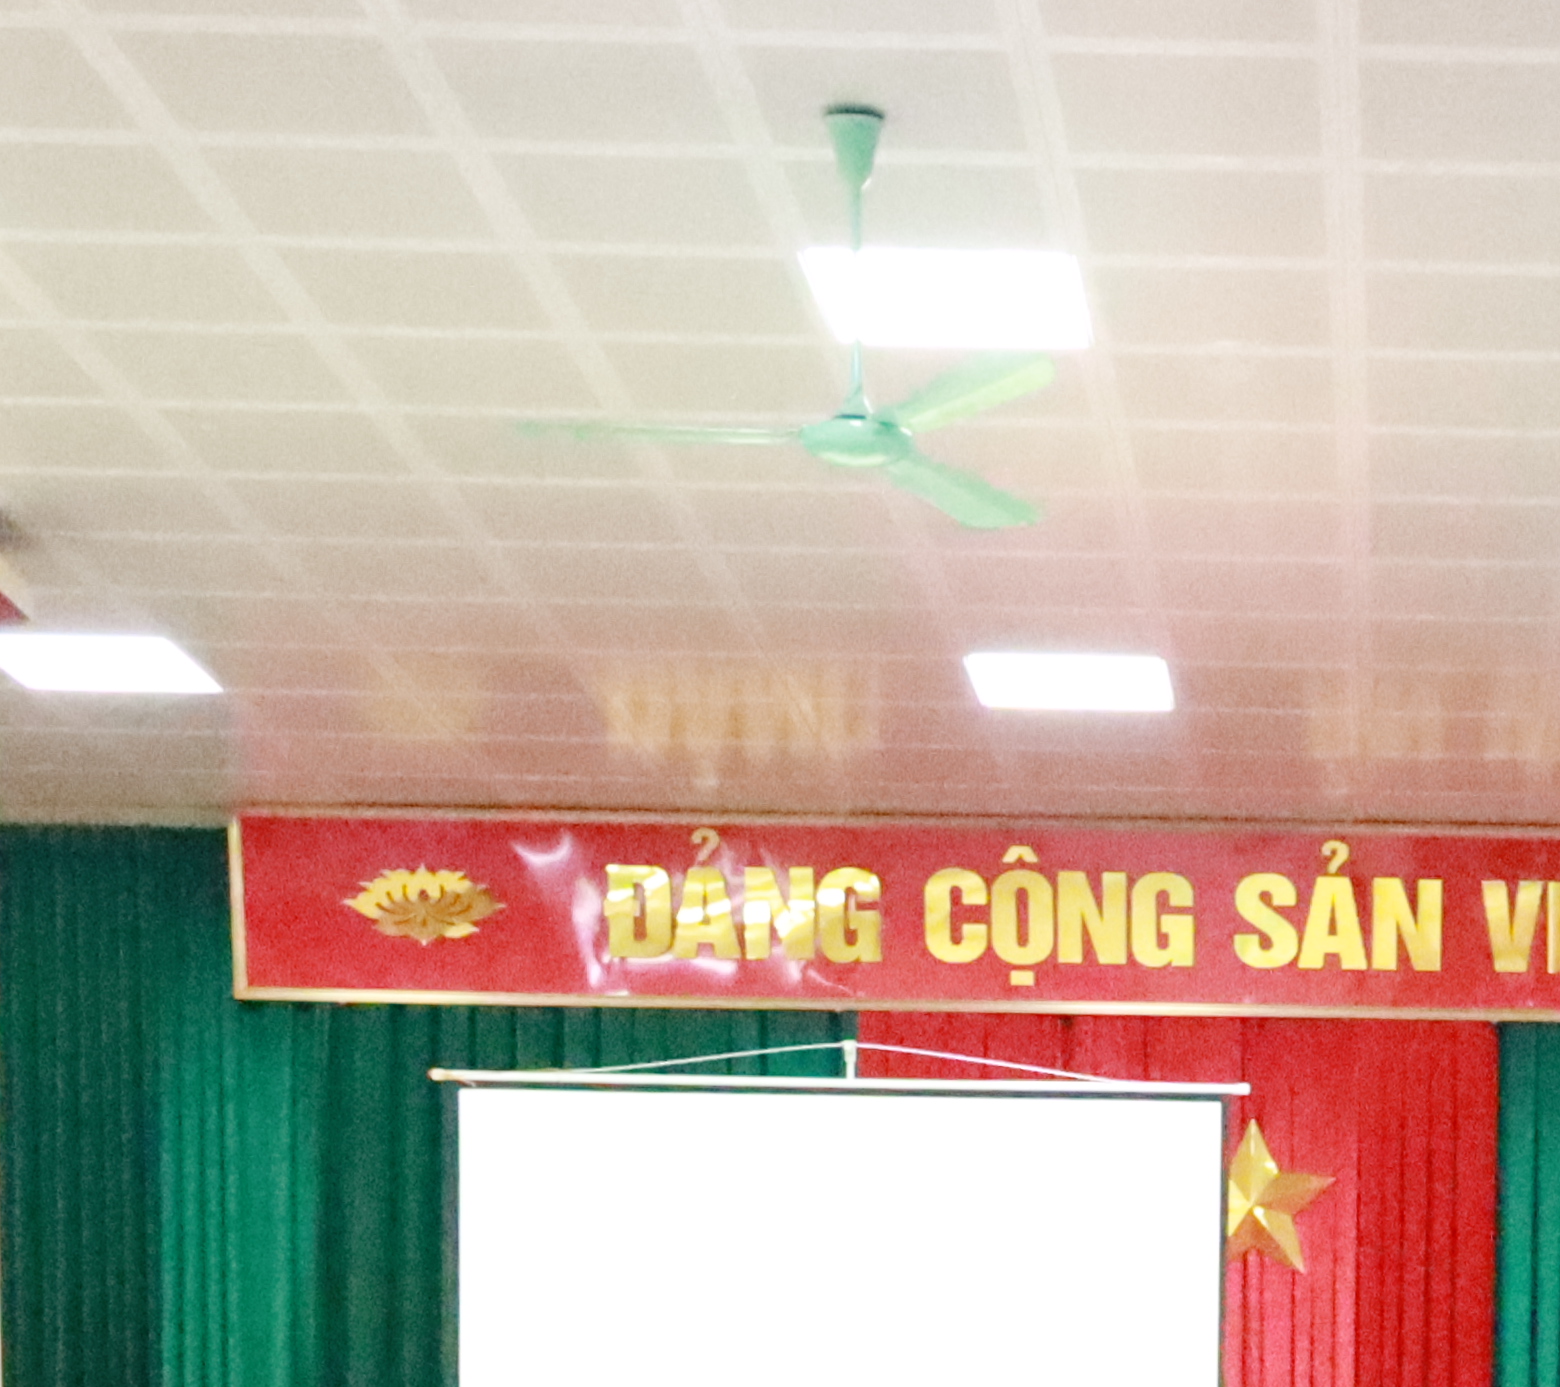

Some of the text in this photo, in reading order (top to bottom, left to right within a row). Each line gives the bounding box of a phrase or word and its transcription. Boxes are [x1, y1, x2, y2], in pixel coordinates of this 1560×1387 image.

[604, 828, 883, 963] ĐẢNG
[924, 844, 1194, 986] CỘNG
[1235, 842, 1442, 973] SẢN
